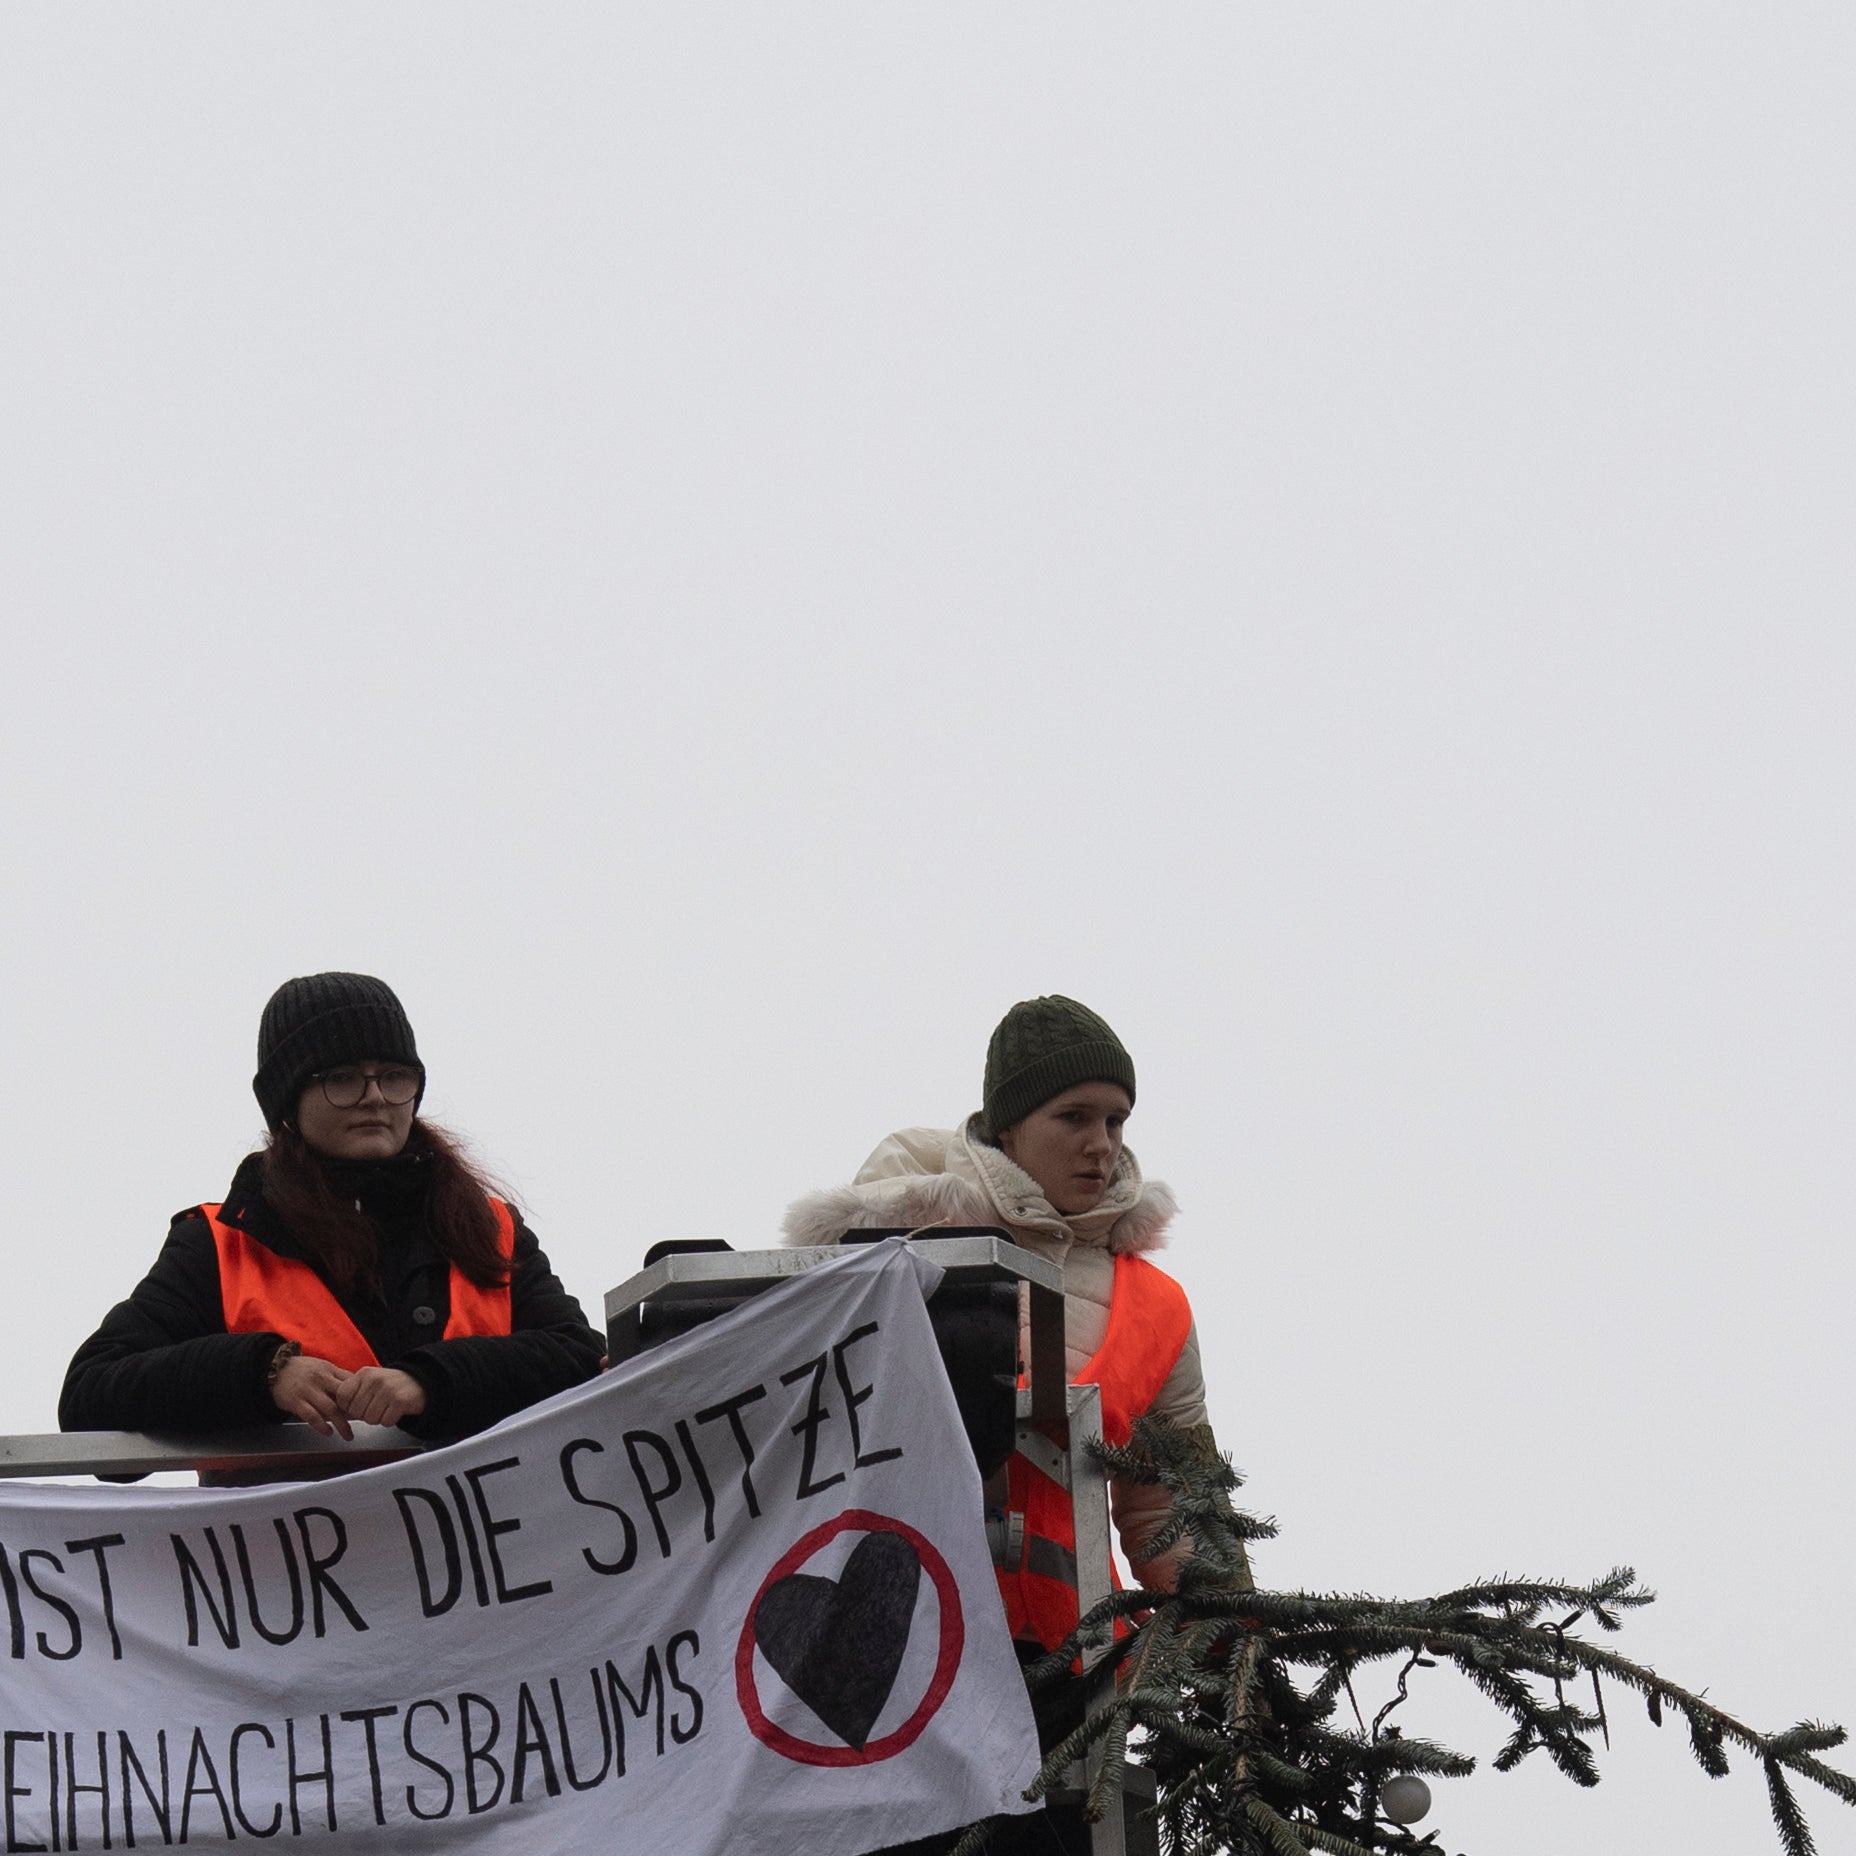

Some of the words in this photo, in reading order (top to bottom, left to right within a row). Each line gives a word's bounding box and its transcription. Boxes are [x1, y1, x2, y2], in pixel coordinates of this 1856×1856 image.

[169, 1506, 369, 1649] NUR
[391, 1456, 554, 1619] DIE
[559, 1321, 904, 1577] SPITZE
